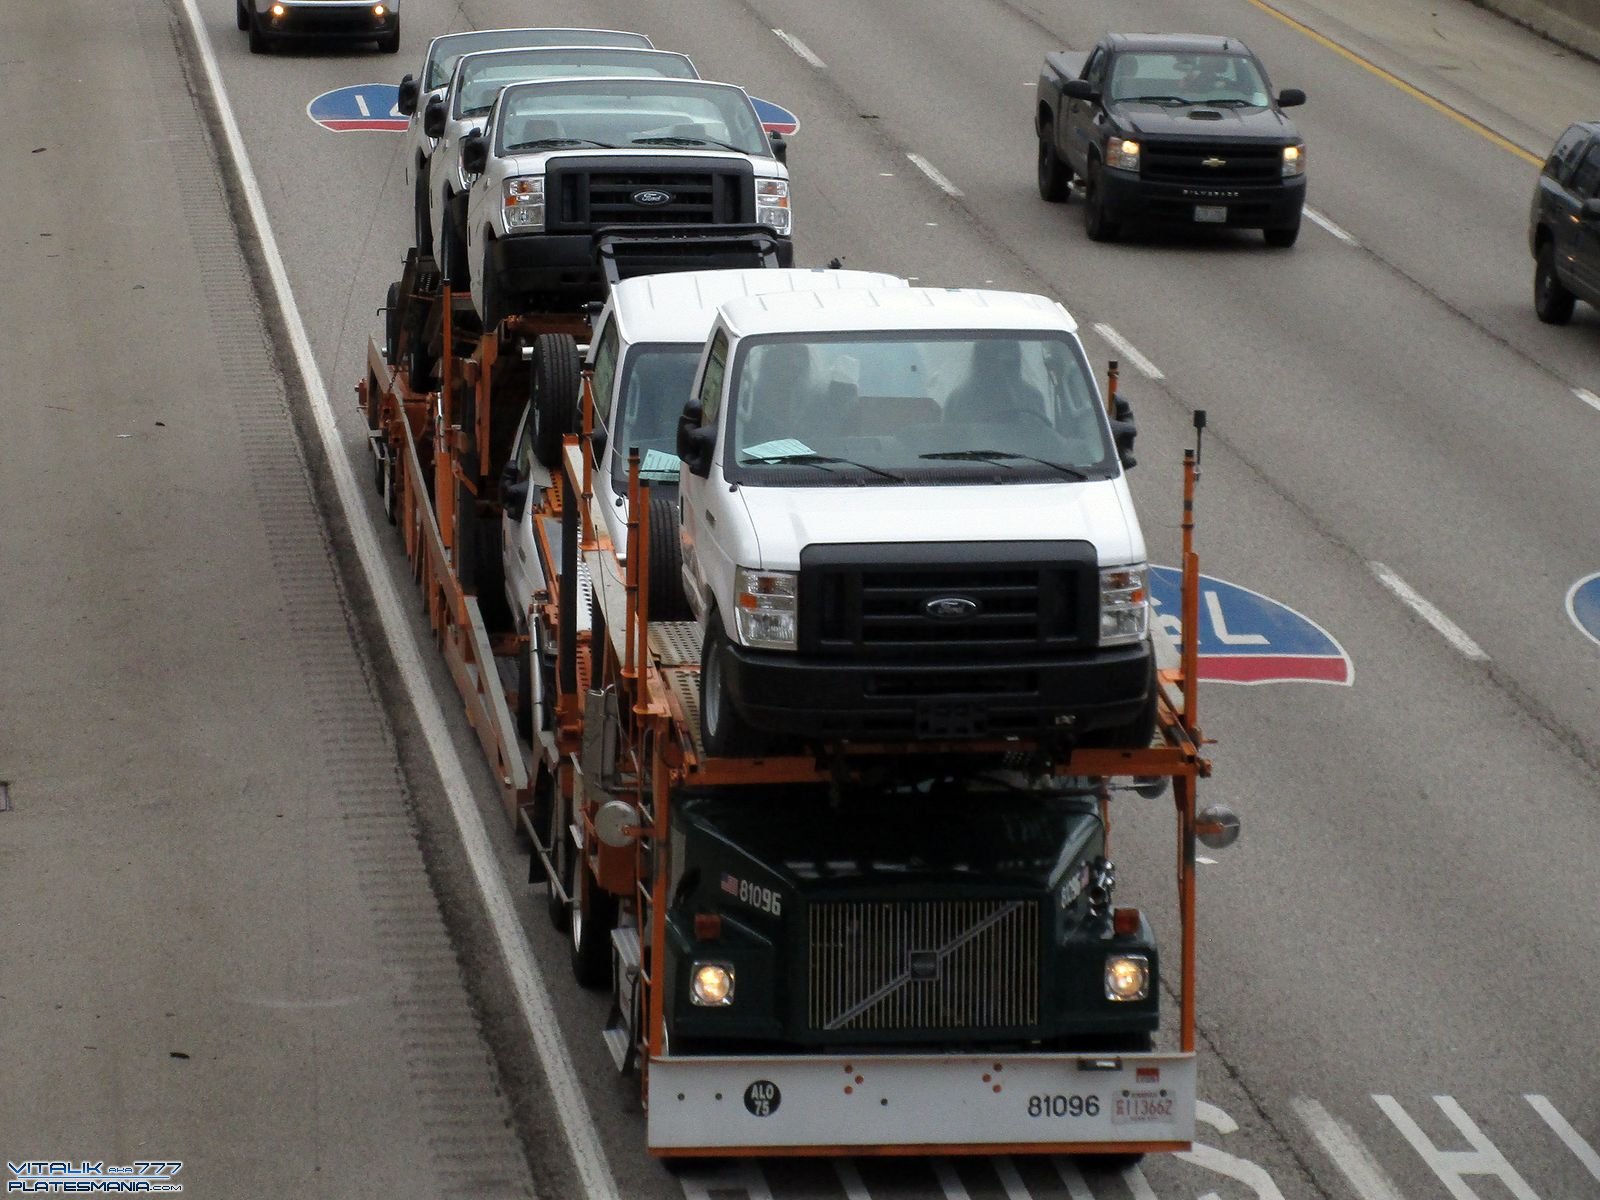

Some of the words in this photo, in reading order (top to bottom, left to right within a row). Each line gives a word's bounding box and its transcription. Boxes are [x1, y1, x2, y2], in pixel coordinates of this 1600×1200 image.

[740, 879, 782, 916] 81096
[751, 1083, 775, 1100] ALO
[754, 1100, 770, 1117] 75
[1027, 1094, 1101, 1118] 81096
